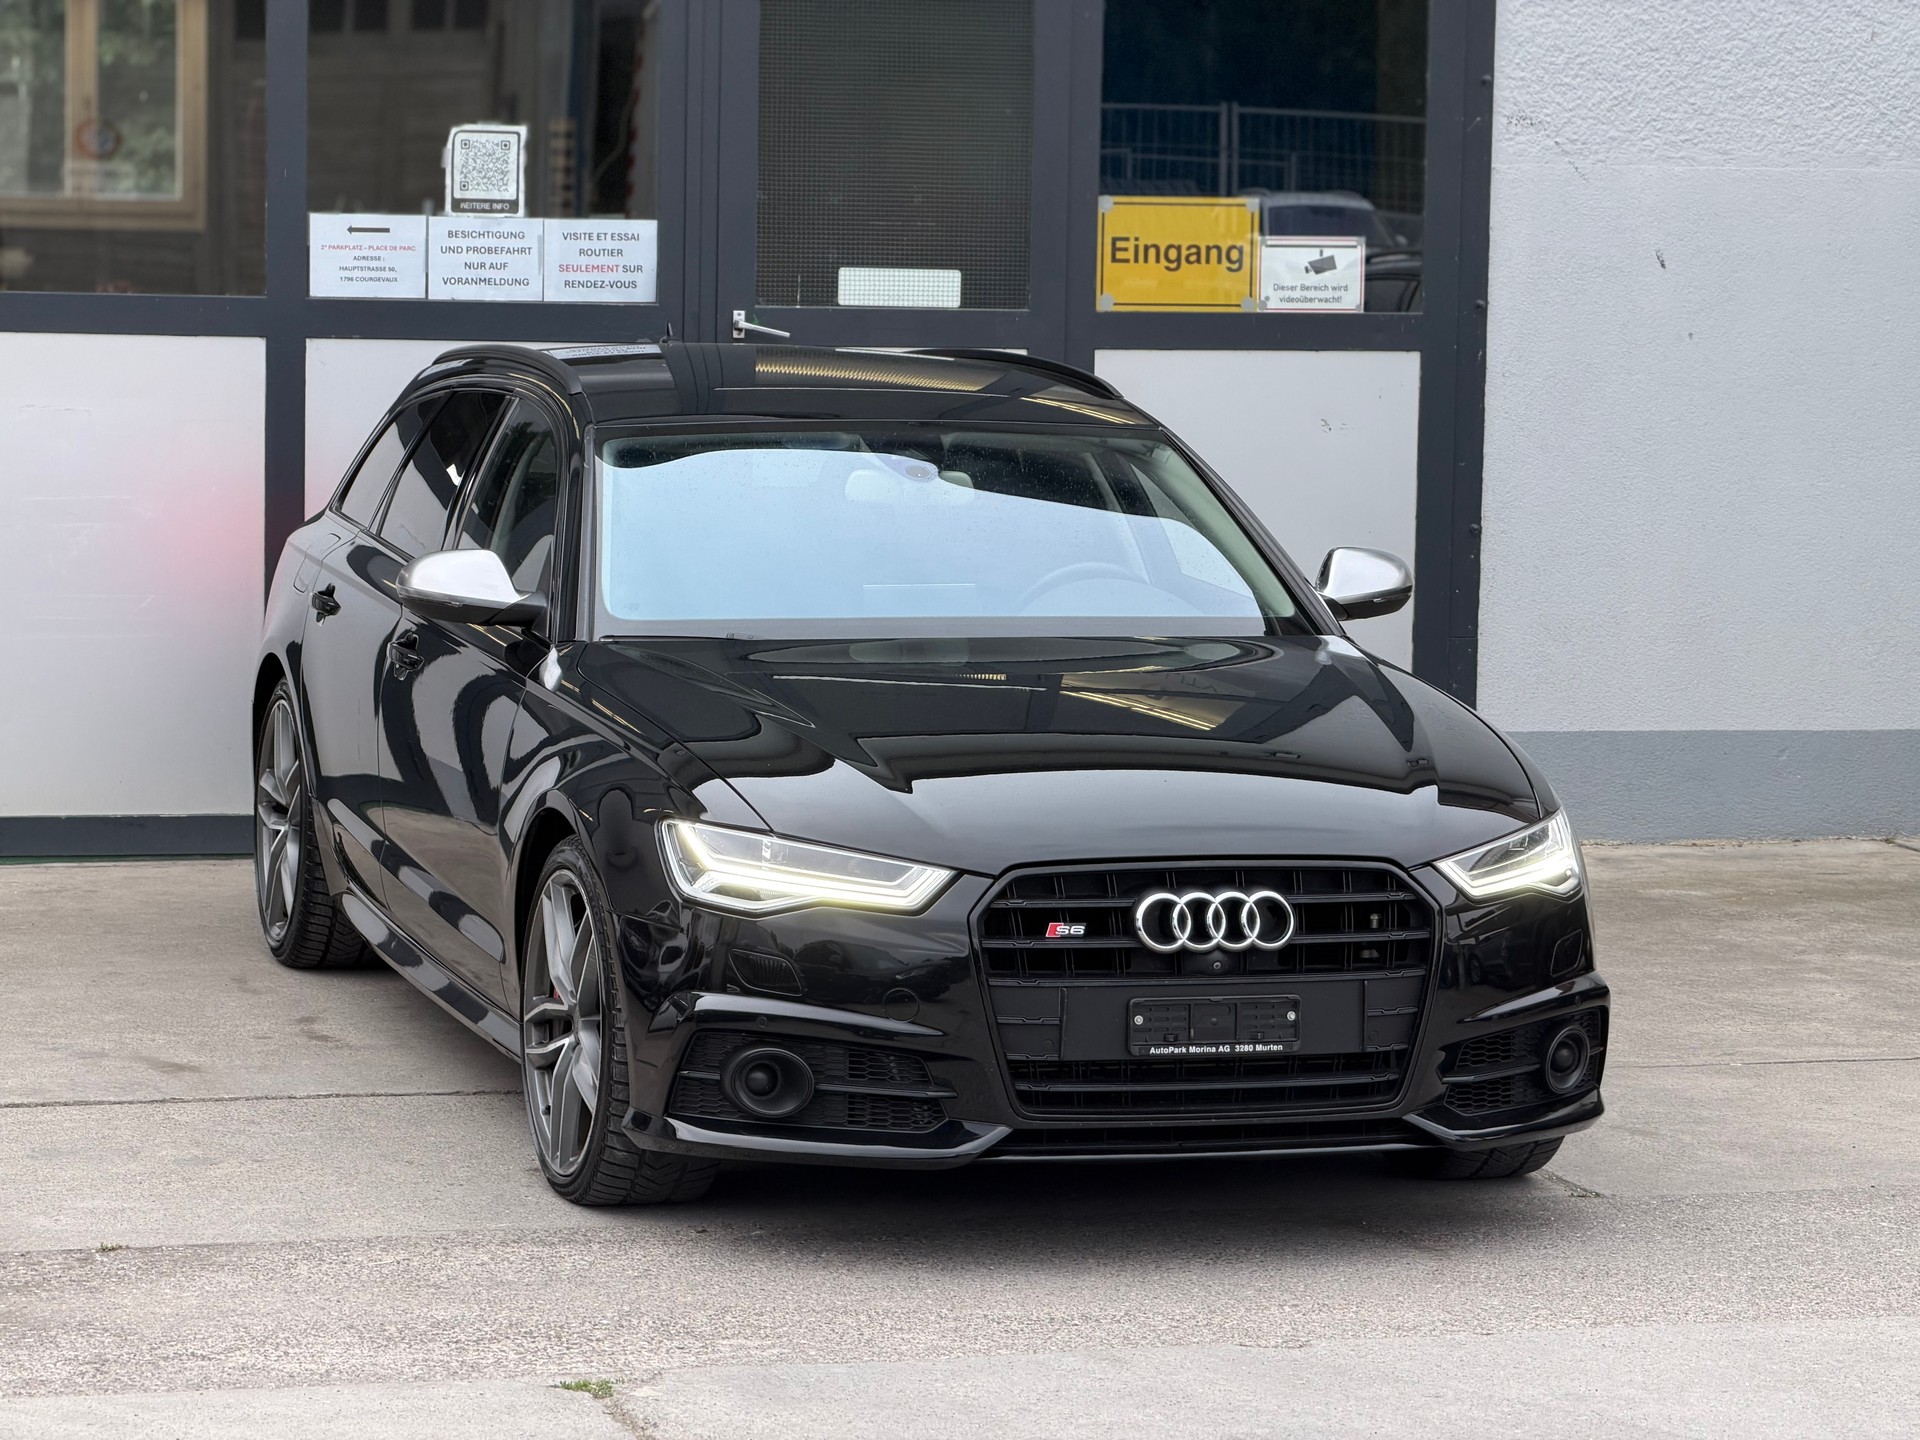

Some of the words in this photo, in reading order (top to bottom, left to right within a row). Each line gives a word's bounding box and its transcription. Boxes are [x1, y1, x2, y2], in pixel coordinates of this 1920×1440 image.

[447, 230, 525, 239] BESICHTIGUNG
[562, 232, 594, 241] VISITE
[597, 232, 608, 241] ET
[611, 233, 640, 241] ESSAI
[440, 245, 463, 254] UND
[466, 246, 533, 255] PROBEFAHRT
[579, 248, 624, 257] ROUTIER
[1111, 236, 1244, 272] Eingang
[464, 261, 487, 270] NUR
[488, 262, 509, 270] AUF
[559, 264, 620, 273] SEULEMENT
[622, 264, 643, 273] SUR
[442, 276, 530, 286] VORANMELDUNG
[564, 280, 637, 289] RENDEZ-VOUS
[1273, 283, 1298, 292] Dieser
[1300, 283, 1329, 292] Bereich
[1331, 283, 1348, 292] wird
[1279, 294, 1342, 304] videoüberwacht!
[1055, 925, 1085, 935] S6
[1149, 1046, 1187, 1054] AutoPark
[1189, 1045, 1216, 1053] Morina
[1218, 1044, 1231, 1053] AG
[1234, 1044, 1253, 1052] 3280
[1255, 1043, 1283, 1051] Murten
